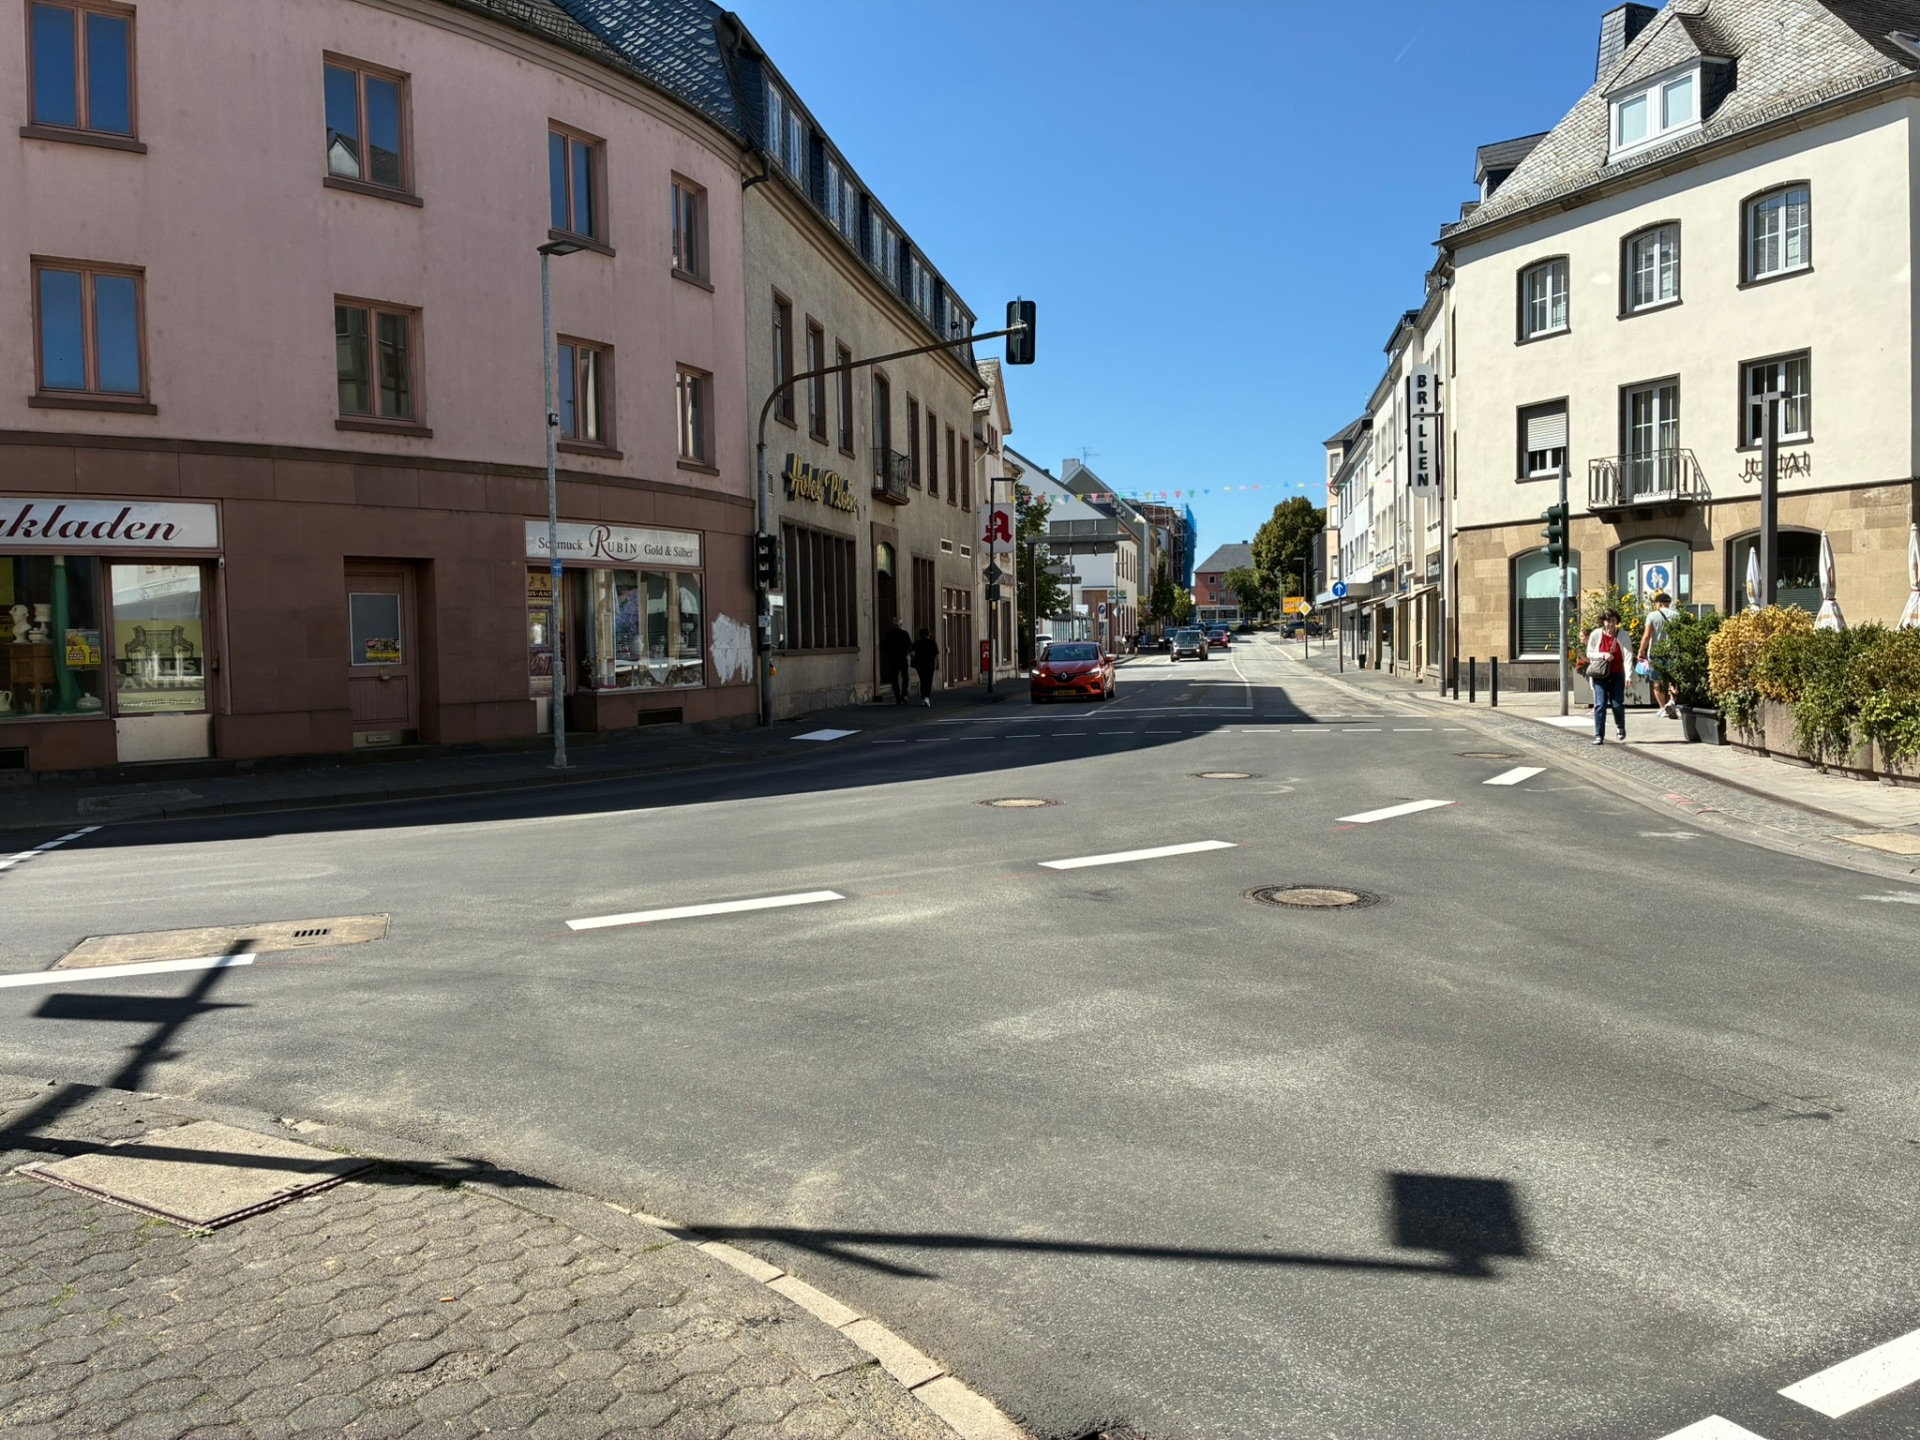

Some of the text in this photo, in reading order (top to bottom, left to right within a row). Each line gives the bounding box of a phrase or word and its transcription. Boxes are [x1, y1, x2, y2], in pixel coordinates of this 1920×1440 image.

[1417, 374, 1429, 487] BRILLEN
[782, 451, 823, 501] Hotel
[538, 537, 583, 551] Scmuck
[644, 544, 664, 556] Gold
[665, 546, 671, 557] &
[673, 546, 694, 559] Silber
